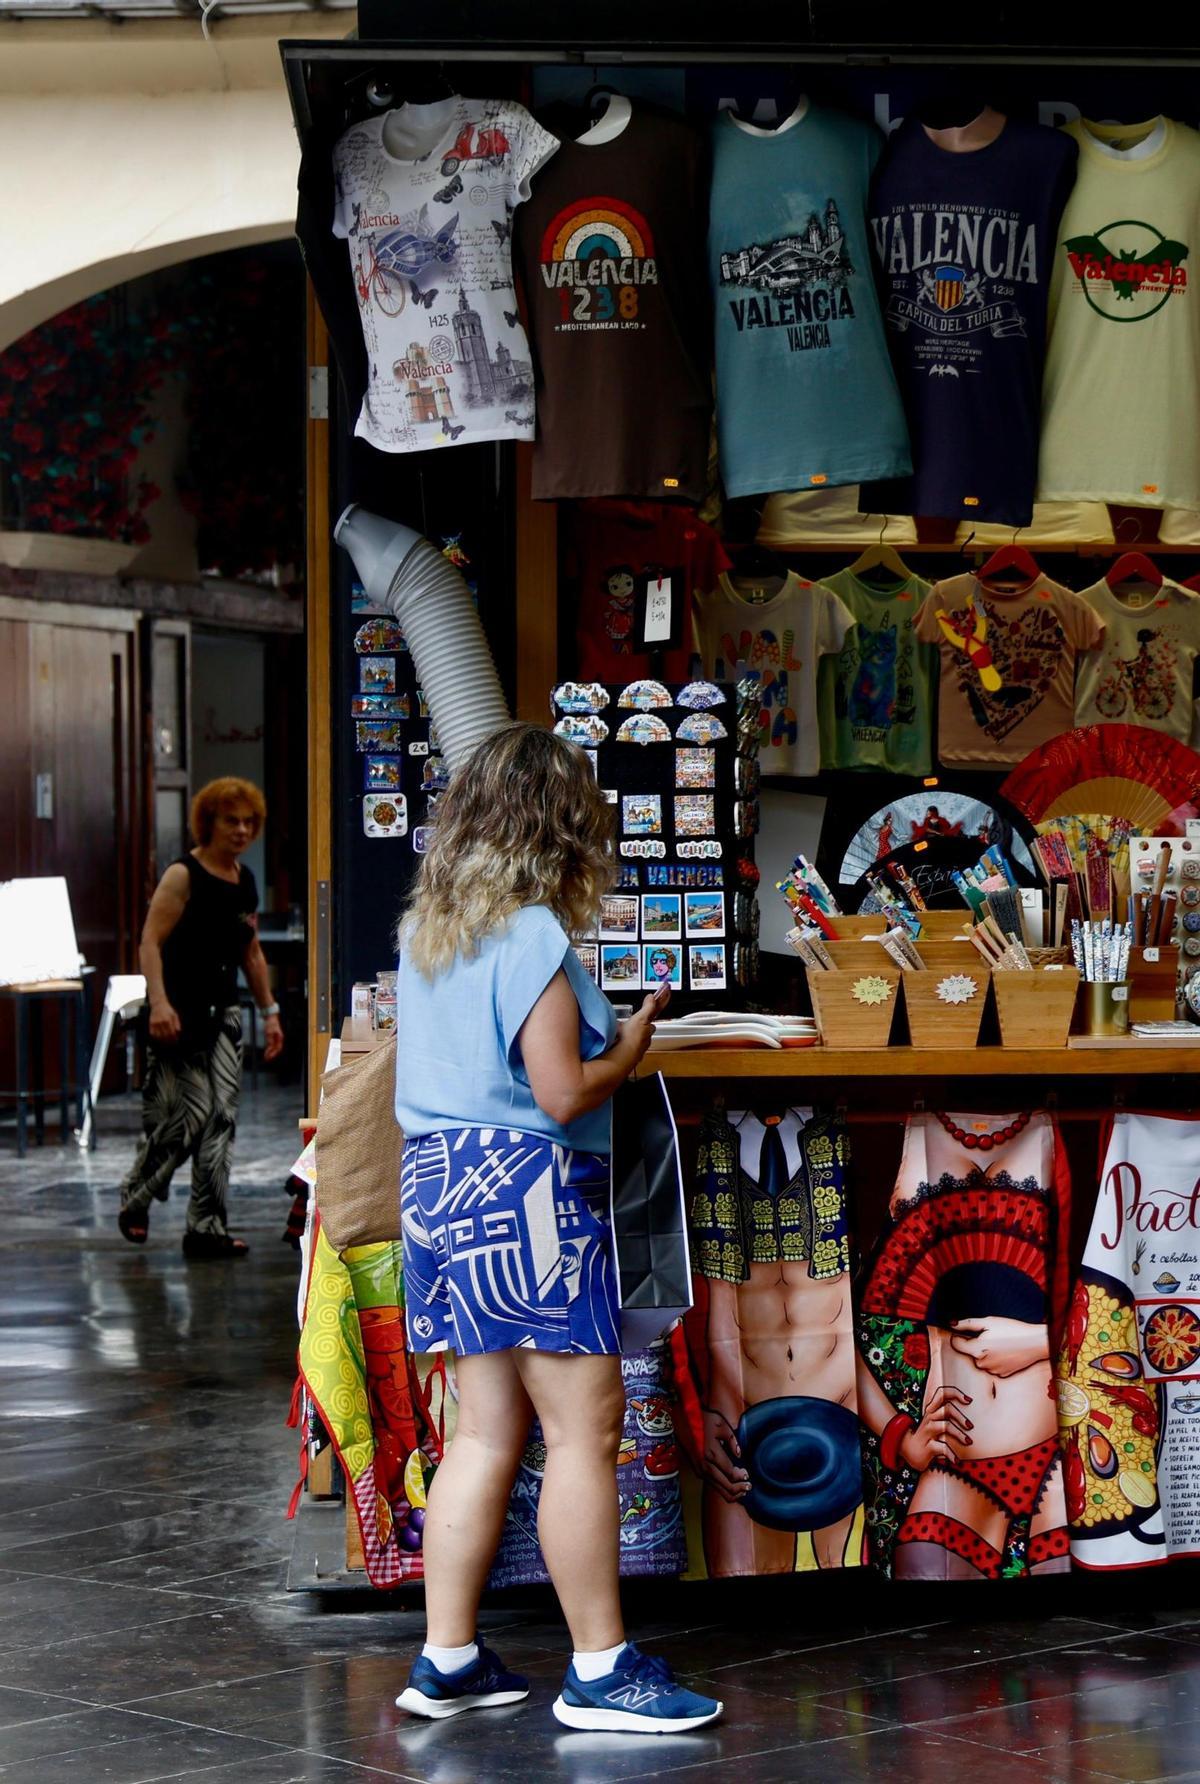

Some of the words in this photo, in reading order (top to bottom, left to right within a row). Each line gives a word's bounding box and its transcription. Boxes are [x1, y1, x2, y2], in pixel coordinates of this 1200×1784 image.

[939, 203, 985, 215] RENOWNED
[870, 212, 1038, 284] VALENCIA
[540, 258, 658, 288] VALENCIA
[1067, 252, 1187, 287] Valencia
[992, 285, 1015, 296] 1238
[559, 285, 639, 320] 1238
[729, 286, 856, 332] VALENCIA
[561, 322, 619, 331] MEDITERRANEAN
[621, 322, 639, 330] LAND
[898, 301, 938, 331] CAPITAL
[940, 318, 963, 332] DEL
[967, 306, 1003, 329] TURIA
[787, 324, 831, 352] VALENCIA
[400, 360, 453, 380] Valencia
[647, 866, 724, 886] VALENCIA
[1149, 1253, 1156, 1264] 2
[1160, 1251, 1198, 1264] cebollas
[1186, 1282, 1198, 1291] de
[503, 1552, 537, 1563] Pinchos
[604, 1683, 658, 1709] N
